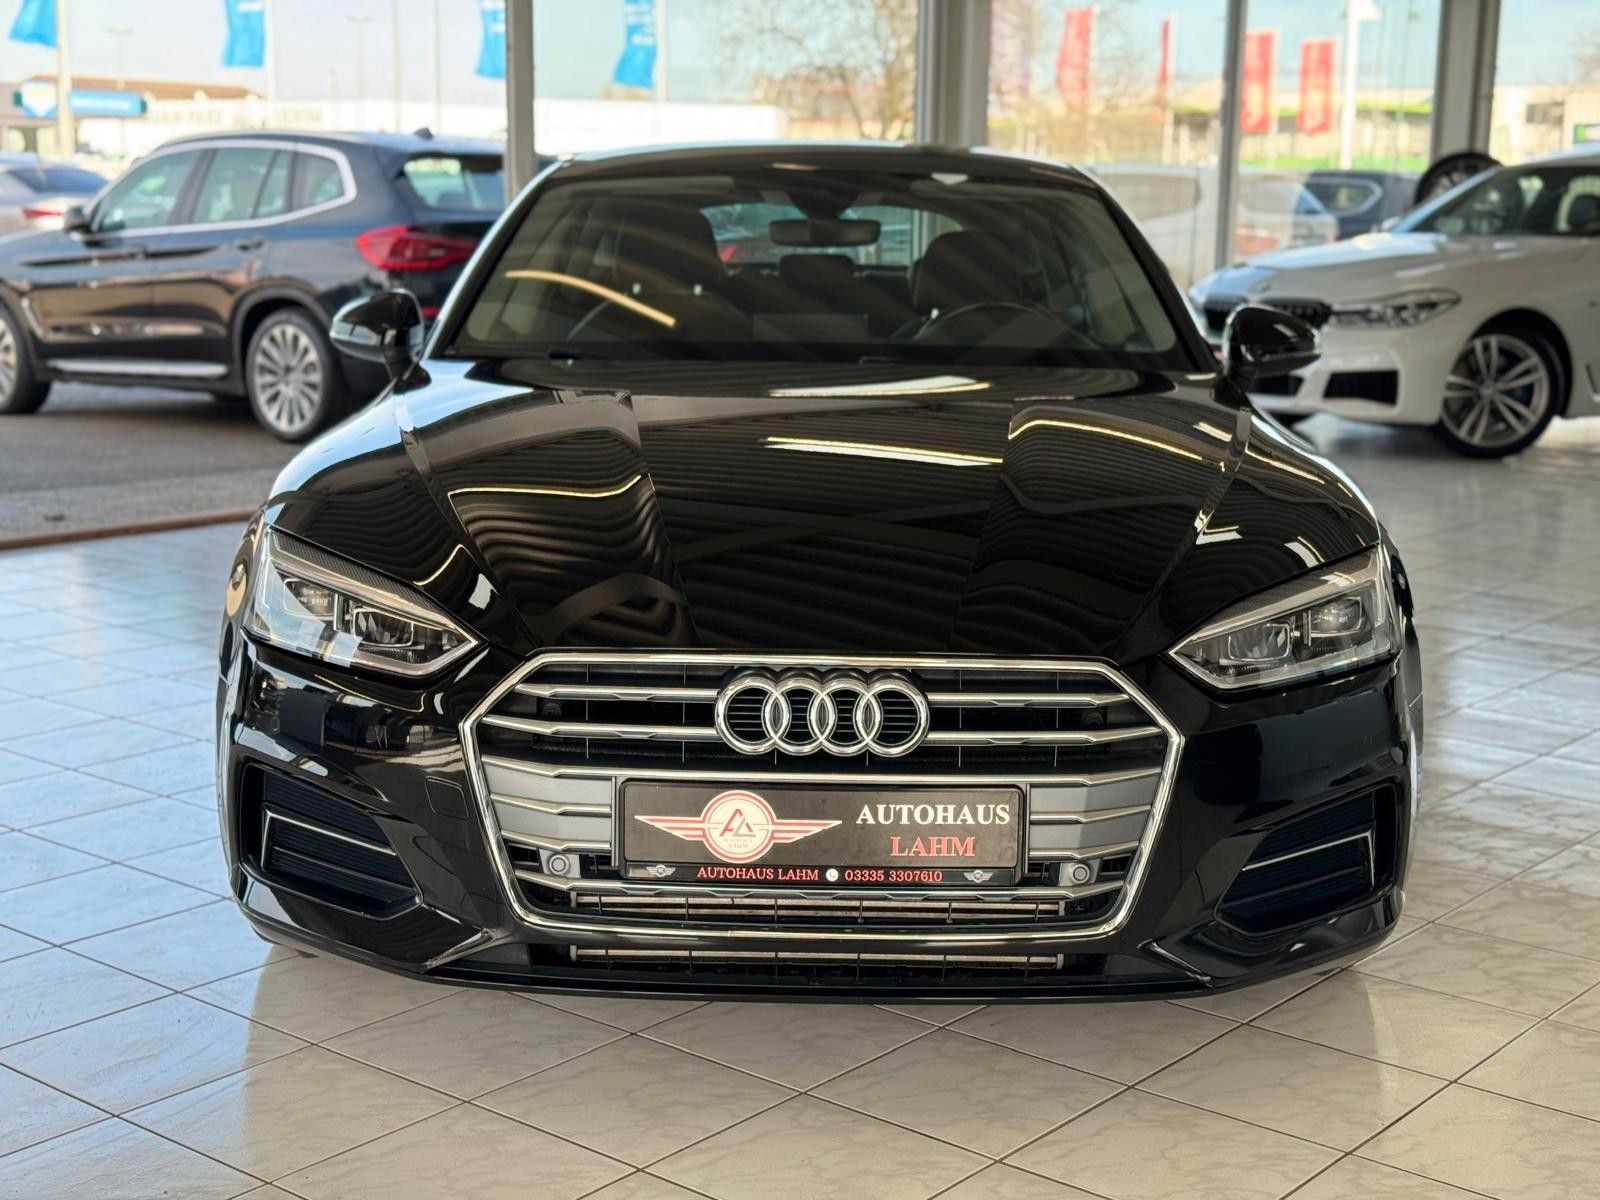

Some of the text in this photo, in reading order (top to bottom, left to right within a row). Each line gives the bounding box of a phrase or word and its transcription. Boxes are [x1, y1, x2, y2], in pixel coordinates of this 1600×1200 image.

[856, 804, 1010, 825] AUTOHAUS
[890, 836, 976, 857] LAHM
[697, 867, 943, 882] AUTOHAUS LAHM 03335 3307610
